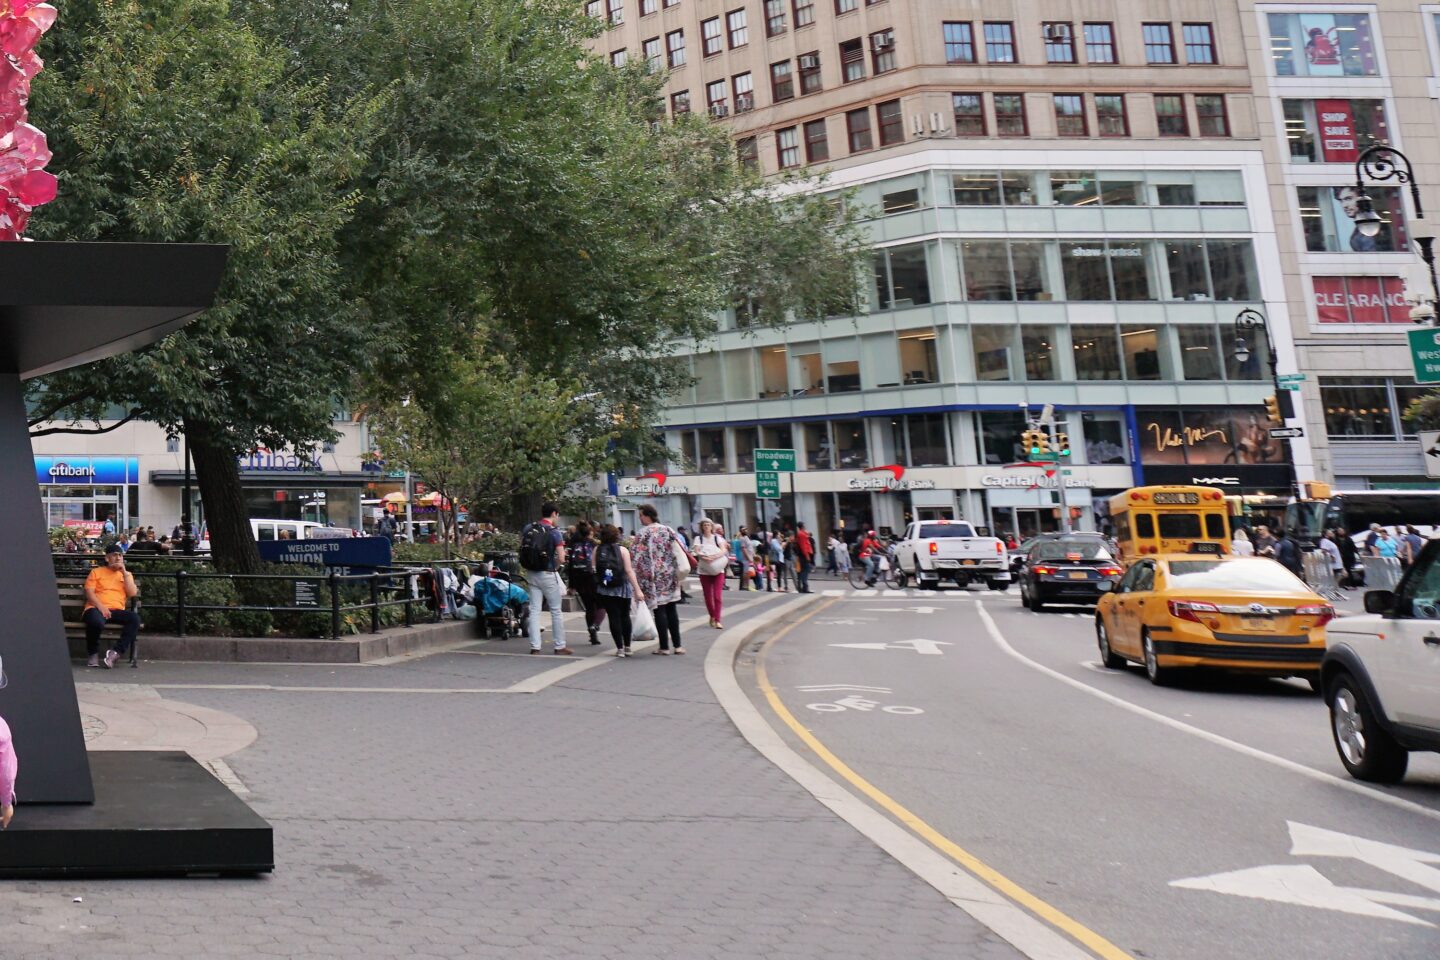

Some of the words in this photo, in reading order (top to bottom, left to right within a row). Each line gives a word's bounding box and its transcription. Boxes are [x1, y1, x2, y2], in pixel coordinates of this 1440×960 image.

[1322, 113, 1348, 122] SHOP
[1324, 127, 1351, 136] SAVE
[1417, 350, 1440, 360] Wes
[756, 452, 794, 461] Broadway
[49, 464, 96, 476] citibank
[847, 478, 886, 489] Capital
[909, 480, 936, 489] Bank
[981, 474, 1035, 487] Capital
[1066, 478, 1097, 488] Bank
[623, 484, 653, 495] Capital
[287, 544, 327, 553] WELCOME
[328, 543, 340, 552] TO
